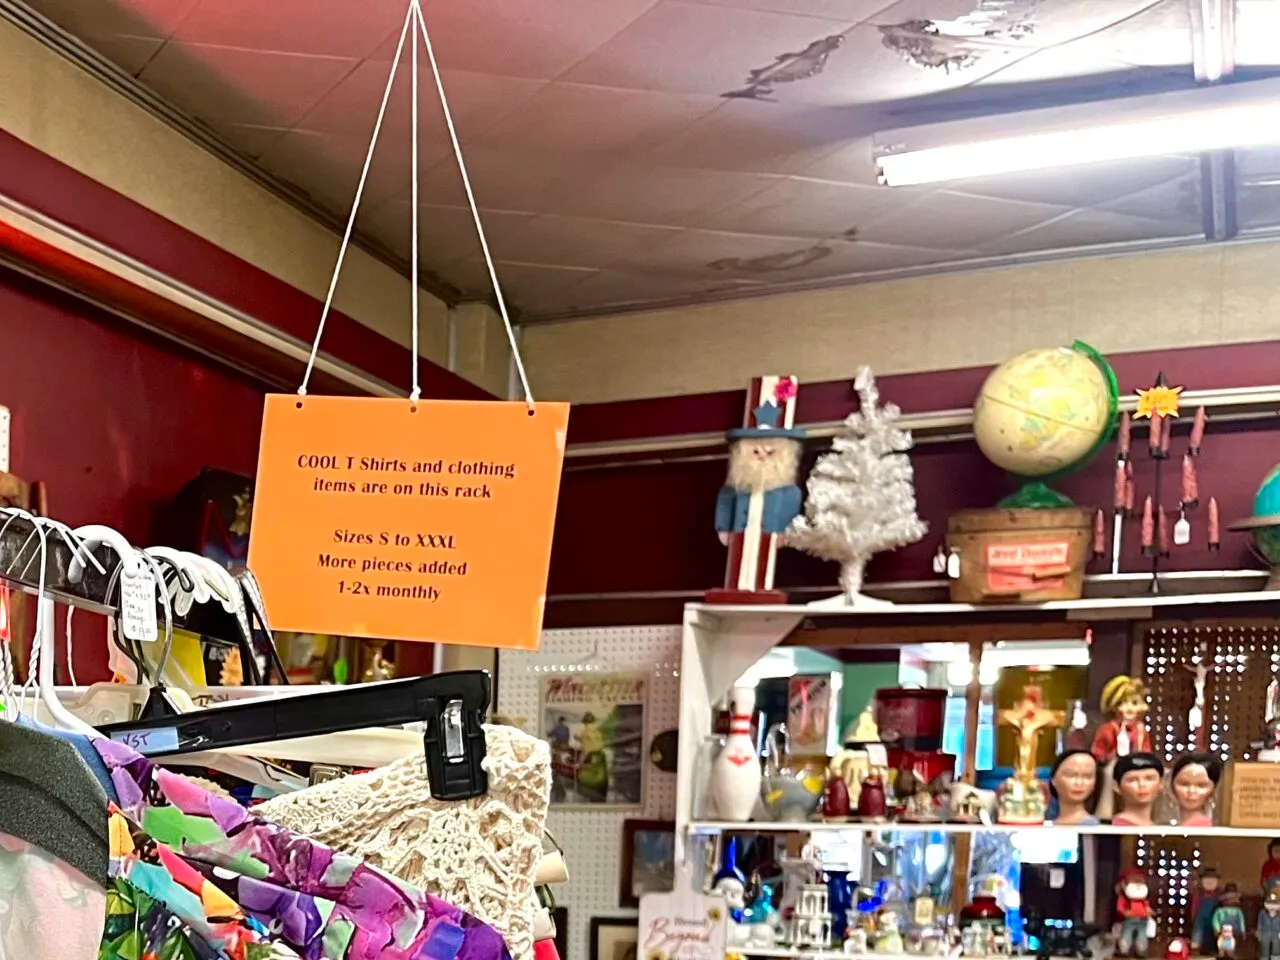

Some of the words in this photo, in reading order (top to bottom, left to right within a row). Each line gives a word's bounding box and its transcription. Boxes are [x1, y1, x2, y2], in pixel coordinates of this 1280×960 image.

[297, 454, 340, 470] COOL
[346, 456, 356, 471] T
[359, 456, 407, 473] Shirts
[413, 459, 443, 475] and
[448, 460, 515, 479] clothing
[313, 477, 356, 493] items
[361, 482, 388, 495] are
[393, 484, 413, 496] on
[419, 482, 449, 498] this
[454, 484, 492, 499] rack
[333, 529, 373, 545] Sizes
[379, 532, 389, 546] S
[395, 533, 410, 547] to
[415, 534, 457, 550] XXXL
[317, 554, 356, 570] More
[362, 556, 412, 574] pieces
[418, 559, 468, 576] added
[337, 580, 370, 596] 1-2x
[376, 583, 442, 602] monthly
[122, 732, 151, 748] VST
